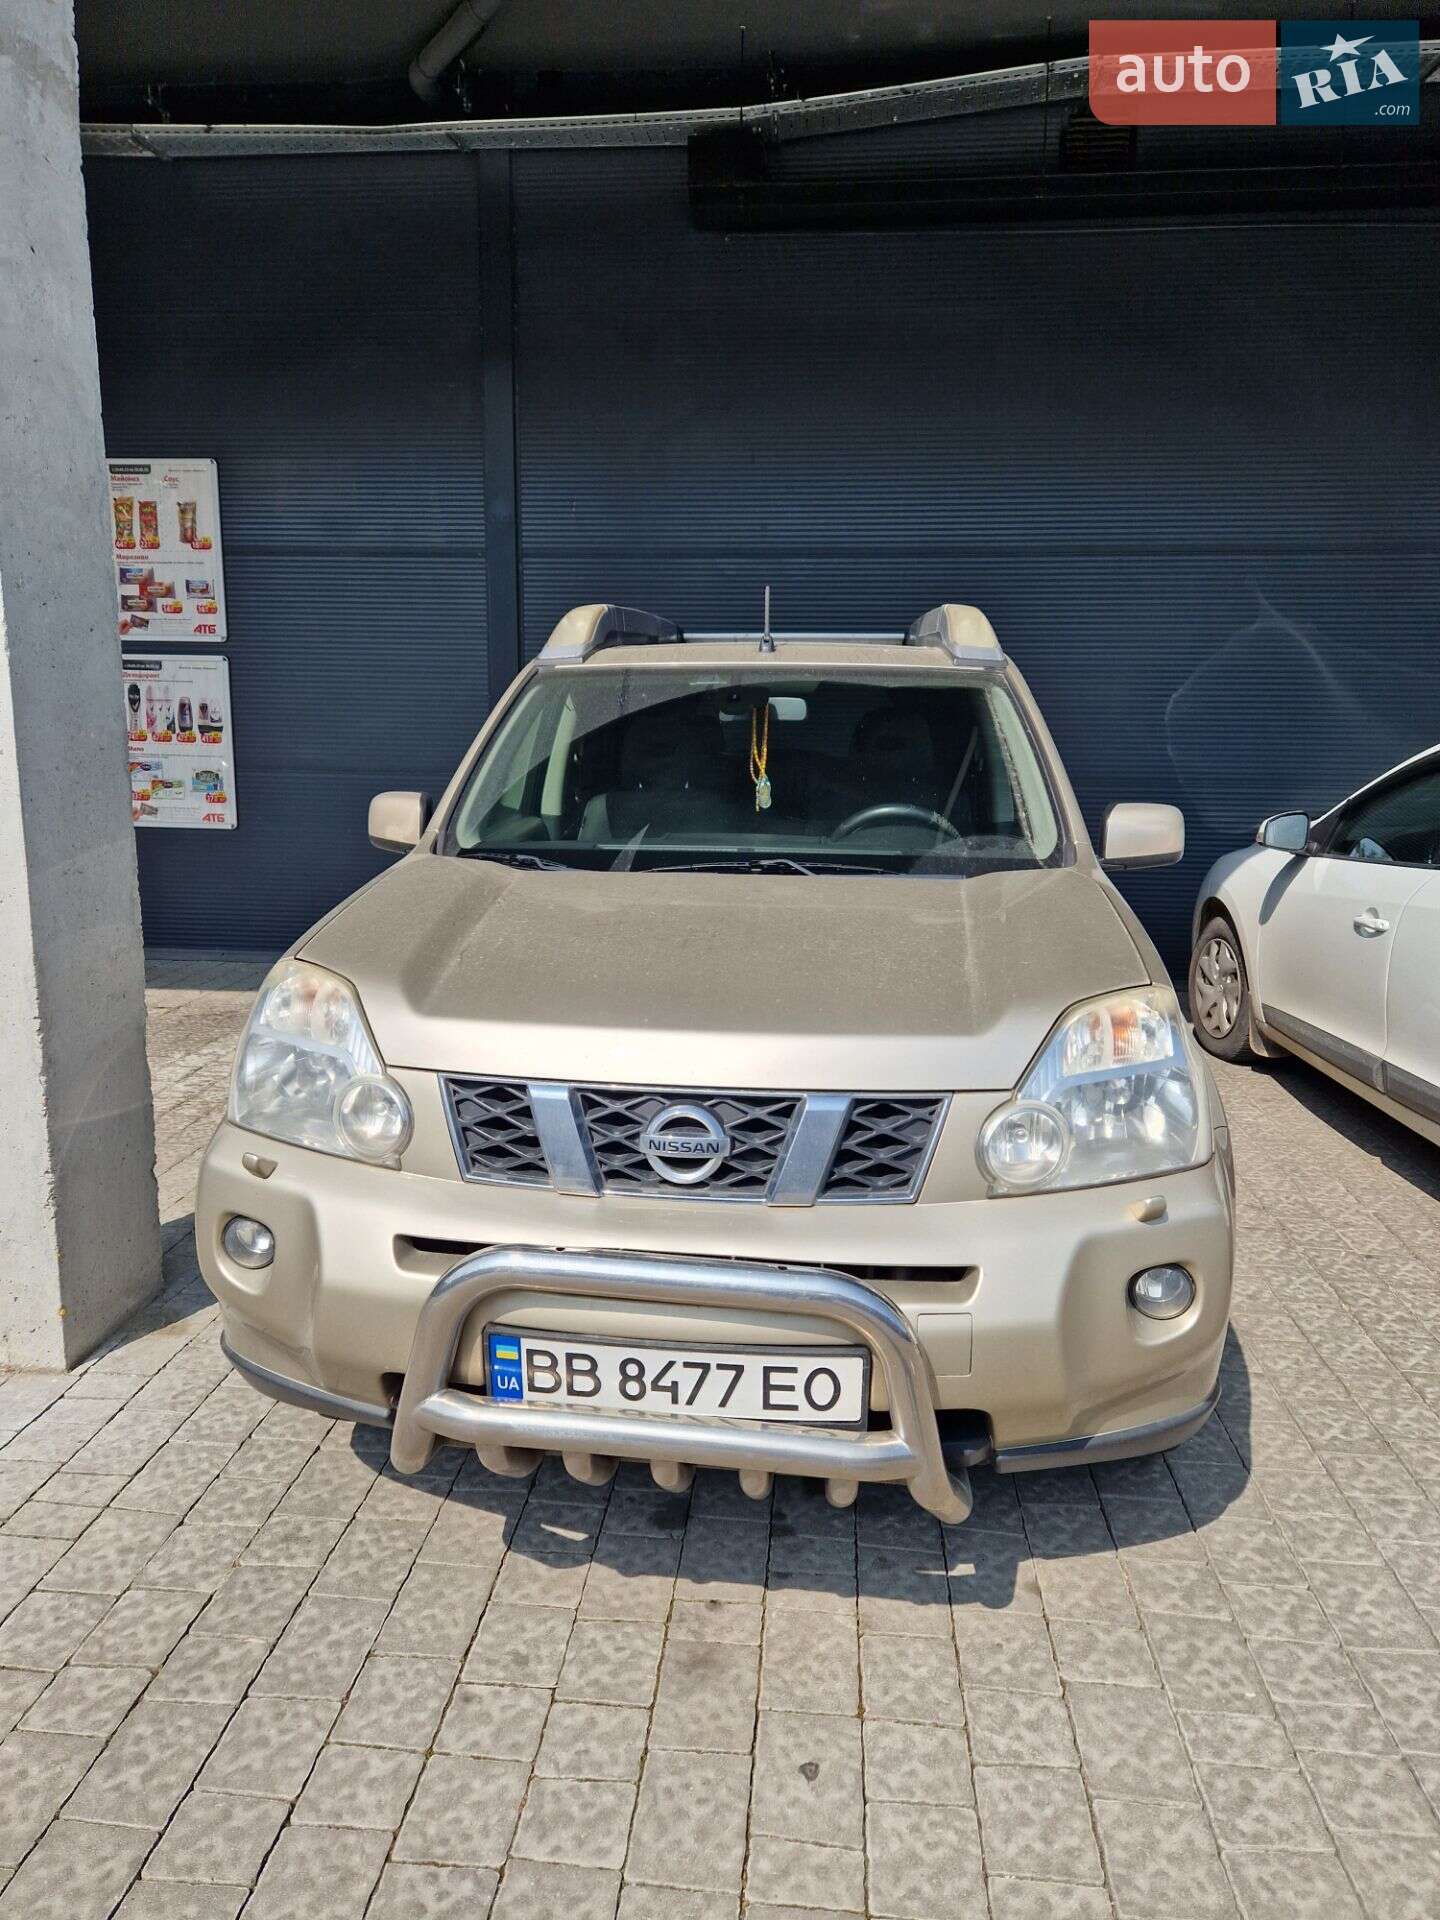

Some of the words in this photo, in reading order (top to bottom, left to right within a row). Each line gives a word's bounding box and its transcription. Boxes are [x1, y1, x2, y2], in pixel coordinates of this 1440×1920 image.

[648, 1139, 720, 1154] NISSAN
[497, 1376, 520, 1391] UA
[525, 1348, 601, 1398] BB
[618, 1357, 745, 1408] 8477
[761, 1366, 842, 1412] EO
